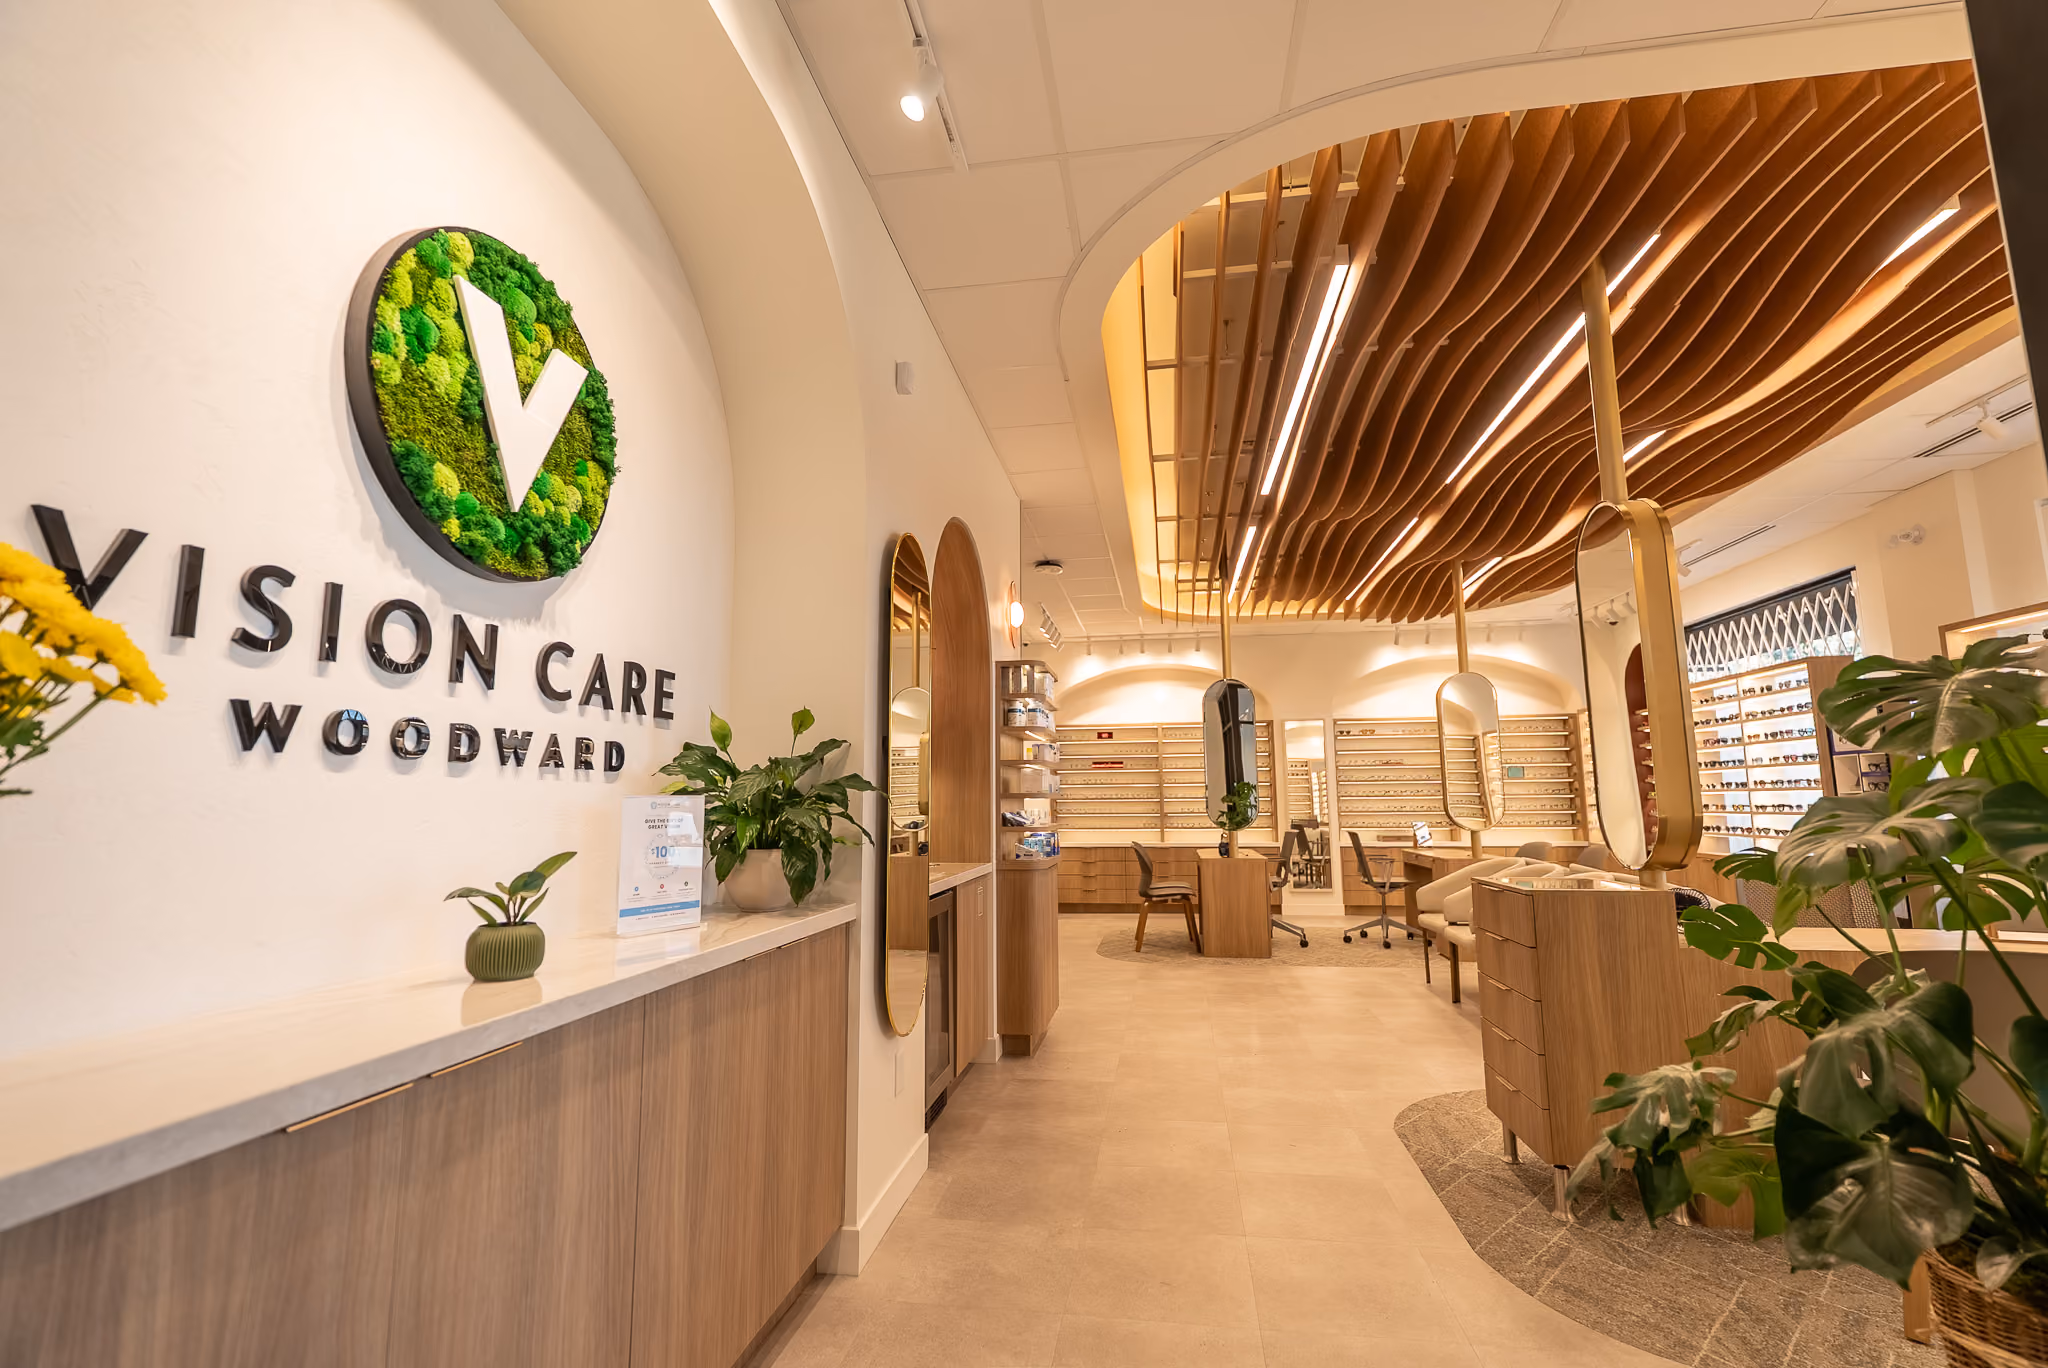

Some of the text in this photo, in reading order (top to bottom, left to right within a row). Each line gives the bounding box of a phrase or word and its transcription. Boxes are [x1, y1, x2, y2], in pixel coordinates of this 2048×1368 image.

[454, 275, 588, 512] V
[31, 504, 677, 721] VISION CARE
[229, 698, 626, 774] WOODWARD
